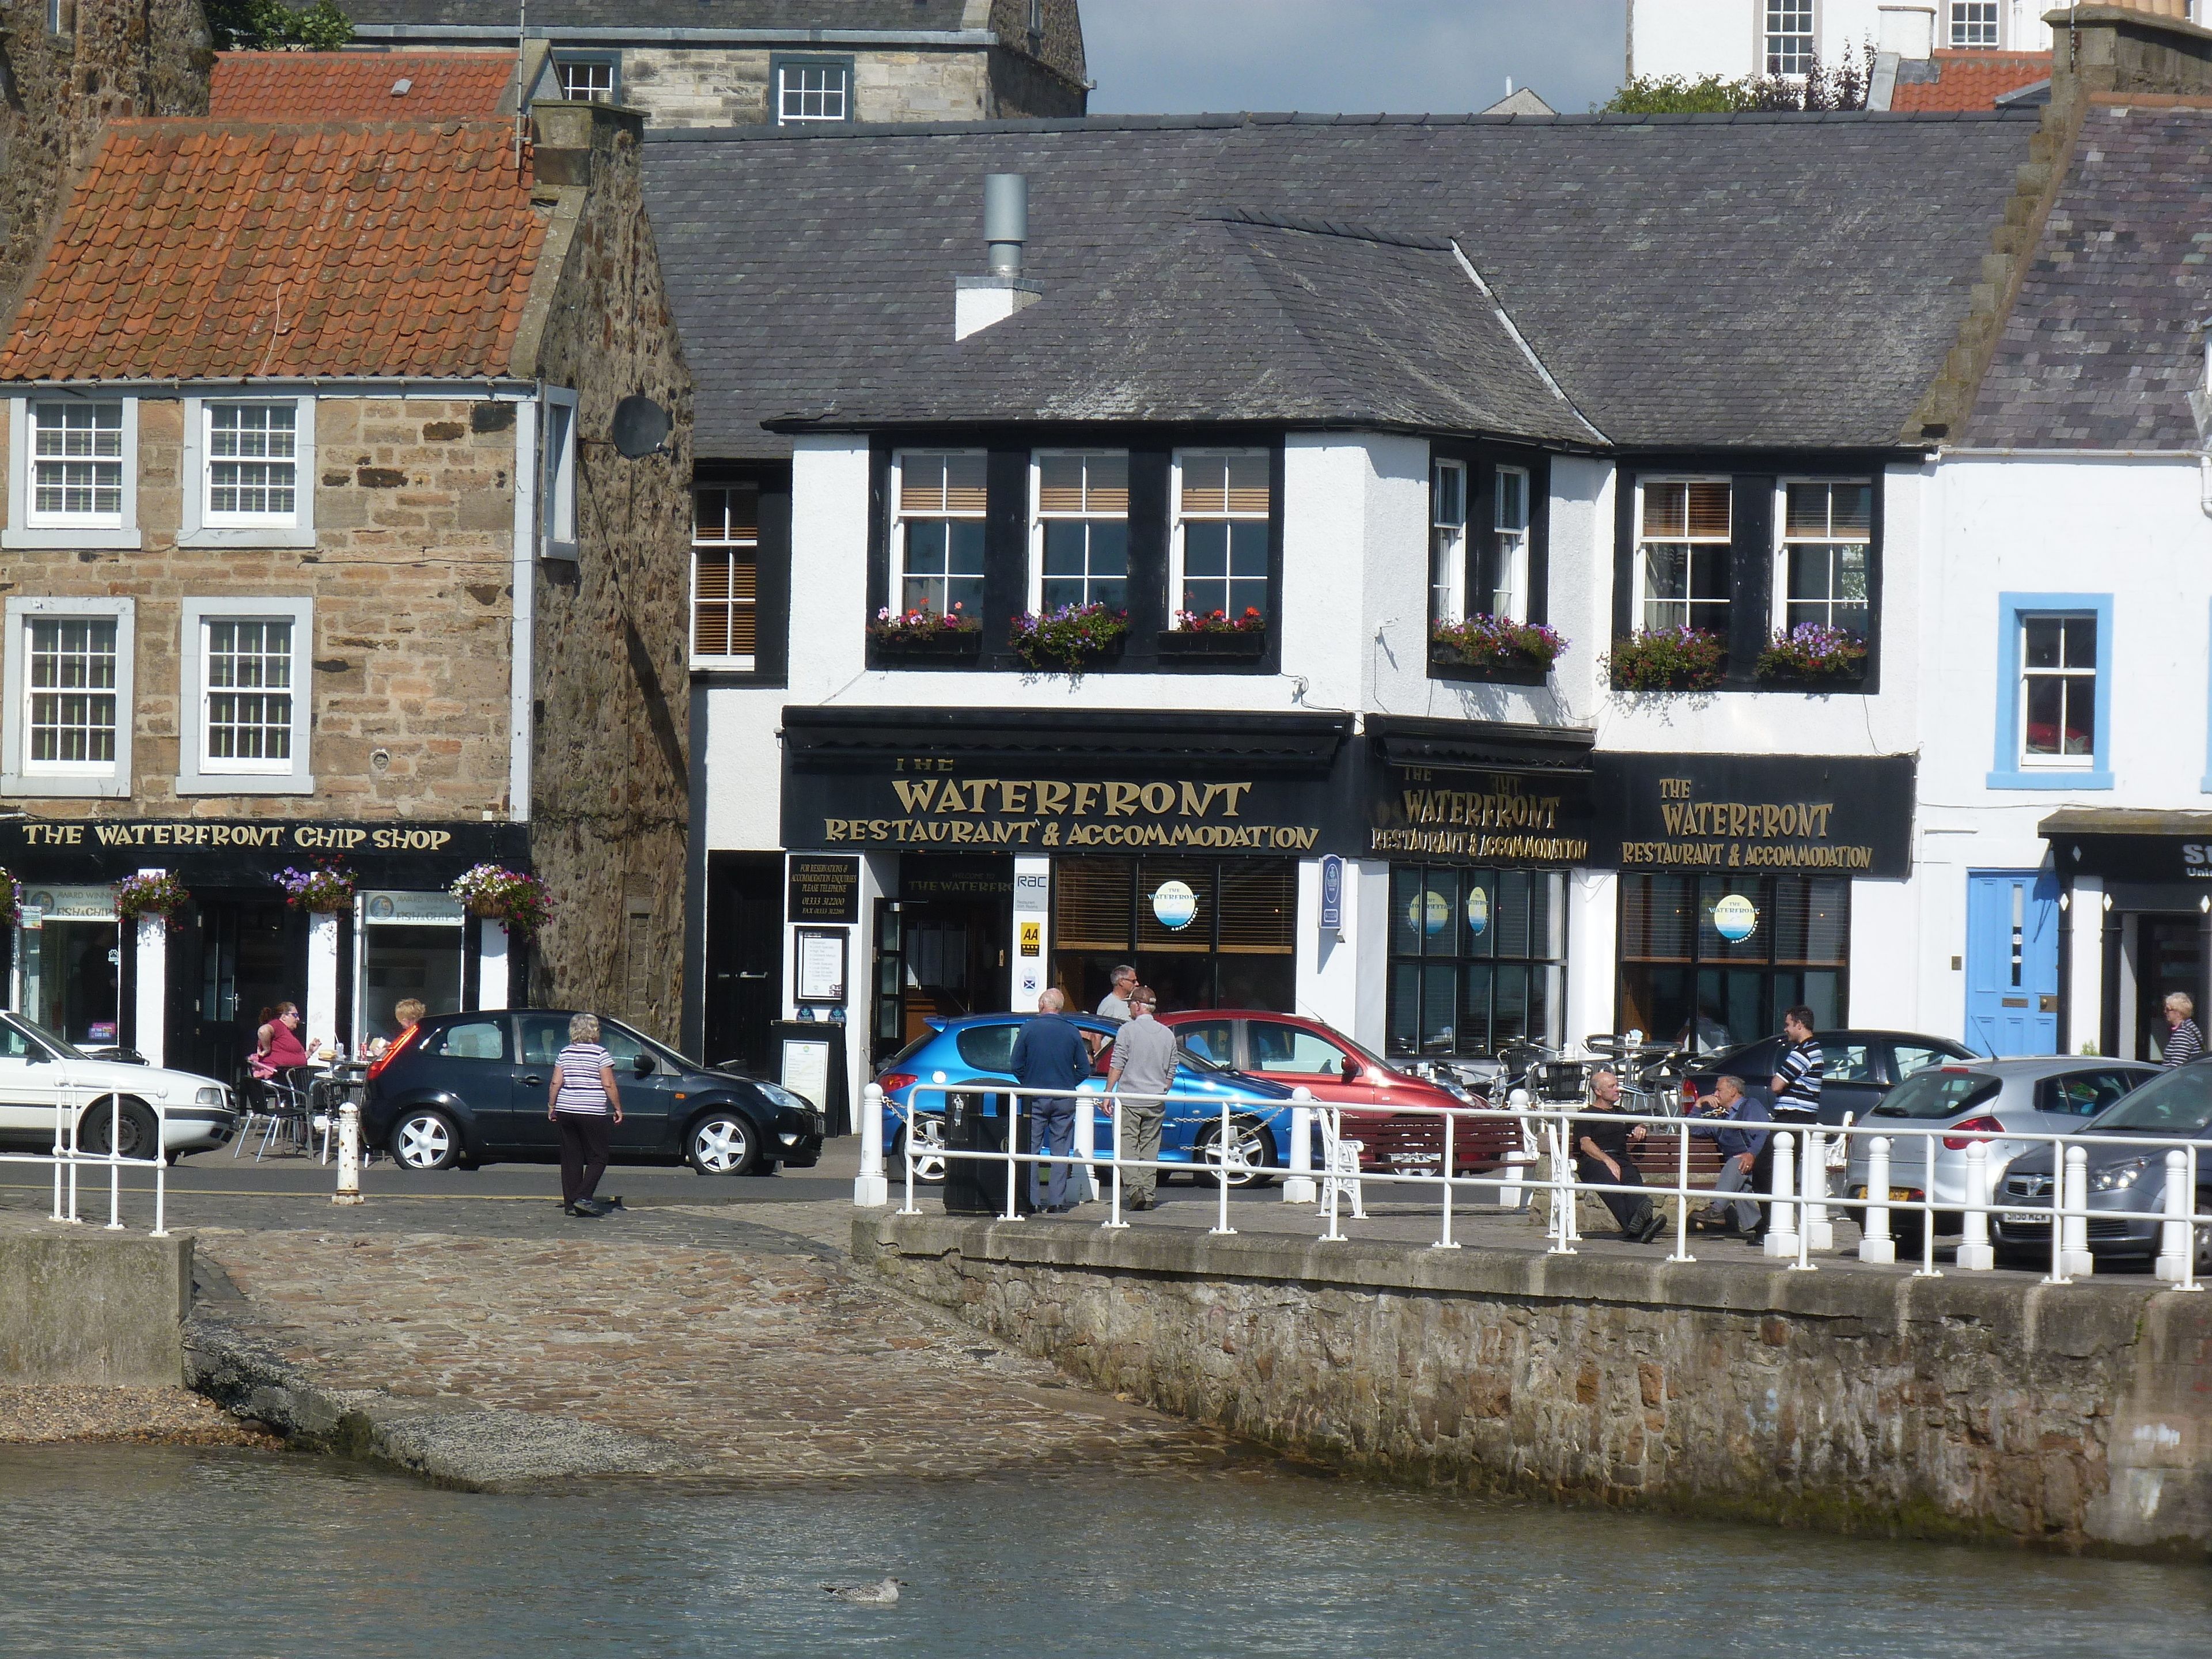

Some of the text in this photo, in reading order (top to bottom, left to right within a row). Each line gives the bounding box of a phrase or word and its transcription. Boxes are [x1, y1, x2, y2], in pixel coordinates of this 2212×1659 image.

[895, 758, 953, 771] THE
[892, 779, 1252, 818] WATERFRONT
[1660, 778, 1691, 800] THE
[1404, 789, 1560, 830] WATERFRONT
[1662, 802, 1833, 838] WATERFRONT
[22, 825, 450, 850] THE WATERFRONT CHIP SHOP
[824, 819, 1320, 850] RESTAURANT & ACCOMMODATION
[1372, 828, 1467, 854] RESTAURANT
[1479, 834, 1589, 860] ACCOMMODATION
[1622, 842, 1873, 868] RESTAURANT & ACCOMMODATION
[940, 881, 1014, 893] WATERFRO
[57, 907, 80, 916] FISH
[85, 907, 113, 916] CHIP
[1023, 929, 1038, 940] AA
